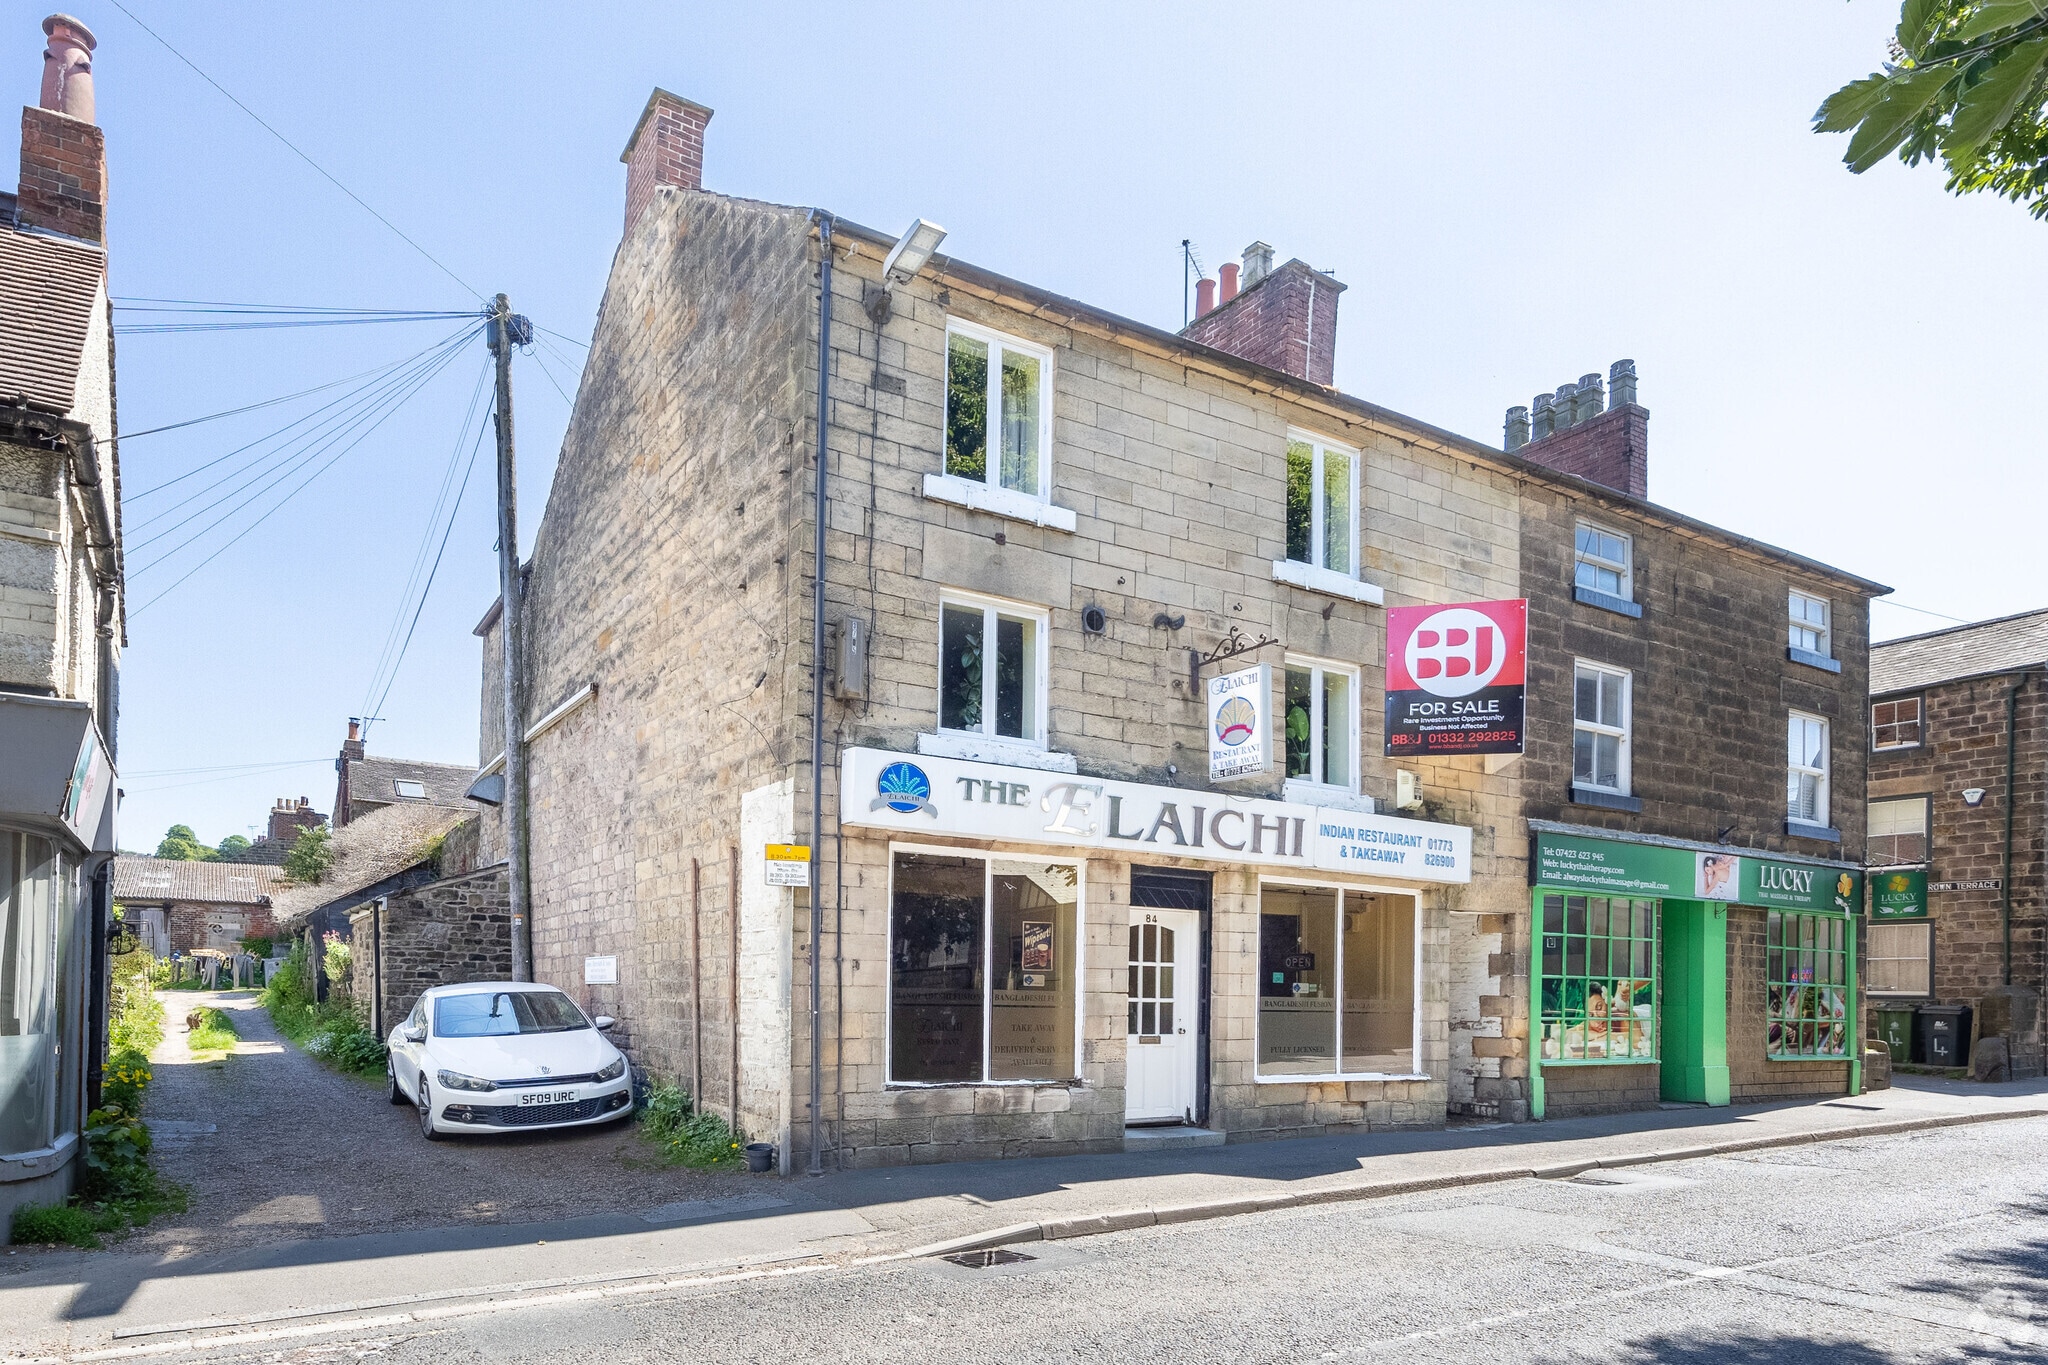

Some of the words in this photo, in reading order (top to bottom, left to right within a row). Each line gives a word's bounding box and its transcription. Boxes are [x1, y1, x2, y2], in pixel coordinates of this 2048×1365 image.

[1416, 626, 1494, 680] BBJ
[1211, 673, 1258, 695] ELAICHI
[1409, 702, 1447, 716] FOR
[1452, 700, 1500, 714] SALE
[1420, 716, 1460, 724] Investment
[1461, 714, 1505, 723] Opportunity
[1391, 733, 1422, 745] BB&J
[1428, 732, 1465, 744] 01332
[1468, 731, 1517, 742] 292825
[1212, 743, 1260, 760] RESTAURANT
[1219, 758, 1237, 769] TAKE
[1240, 754, 1260, 765] AWAY
[887, 793, 920, 802] ELAICHI
[956, 776, 1031, 808] THE
[1040, 782, 1306, 858] ELAICHI
[1319, 824, 1355, 840] INDIAN
[1357, 828, 1423, 848] RESTAURANT
[1427, 838, 1453, 852] 01773
[1340, 845, 1348, 858] &
[1350, 846, 1406, 864] TAKEAWAY
[1424, 853, 1455, 868] 826900
[1543, 846, 1555, 856] Tel:
[1555, 848, 1577, 858] 07423
[1578, 851, 1591, 860] 623
[1592, 852, 1605, 861] 945
[1542, 858, 1559, 868] Web:
[1560, 860, 1625, 875] luckythaitherapy.com
[1542, 870, 1563, 880] Email:
[1759, 865, 1814, 893] LUCKY
[1927, 883, 1952, 891] ROWN
[1956, 881, 1996, 890] TERRACE
[1881, 892, 1918, 902] LUCKY
[1145, 914, 1158, 924] 84
[1285, 957, 1311, 968] OPEN
[1264, 1000, 1309, 1008] BANGLADESHI
[1011, 1024, 1032, 1032] TAKE
[1030, 1036, 1036, 1044] &
[1889, 1030, 1903, 1047] 4
[995, 1046, 1033, 1054] DELIVERY
[1934, 1038, 1949, 1057] 4
[522, 1093, 551, 1105] SF09
[553, 1091, 575, 1103] URC
